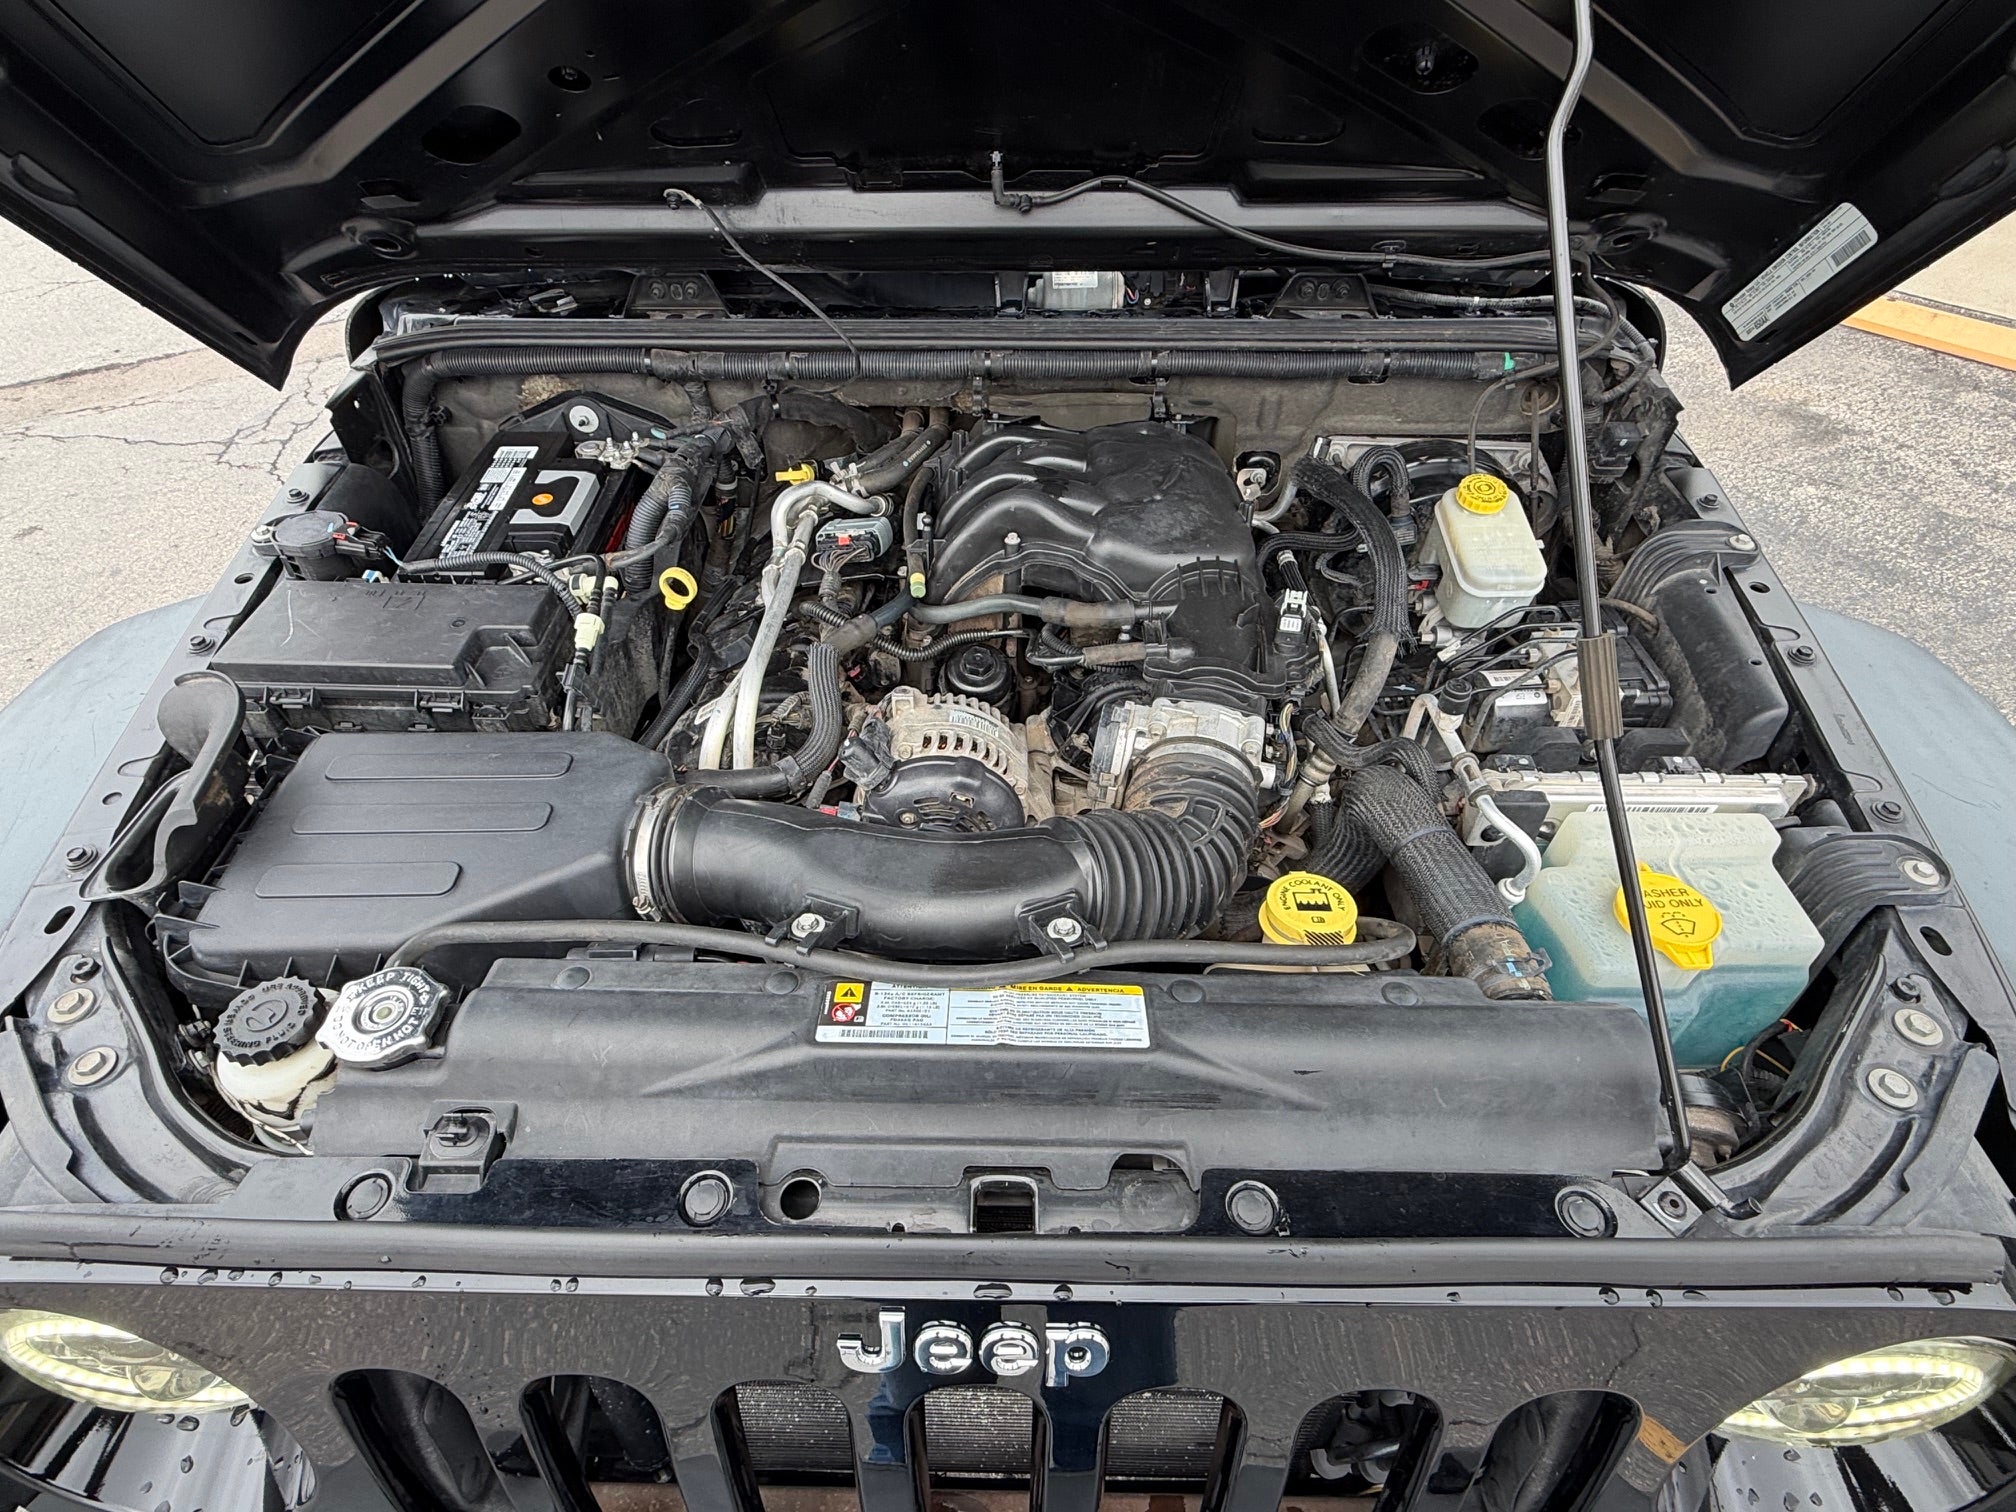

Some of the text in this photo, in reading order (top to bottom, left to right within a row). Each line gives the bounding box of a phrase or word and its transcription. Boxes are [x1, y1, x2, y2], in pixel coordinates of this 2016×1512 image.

[1280, 879, 1346, 911] ENGINE COOLANT ONLY
[1643, 888, 1690, 898] ASHER
[1669, 898, 1704, 908] ONLY
[357, 971, 431, 995] KEEP TIGHT
[393, 1017, 419, 1041] HOT
[837, 1306, 1110, 1387] Jeep
